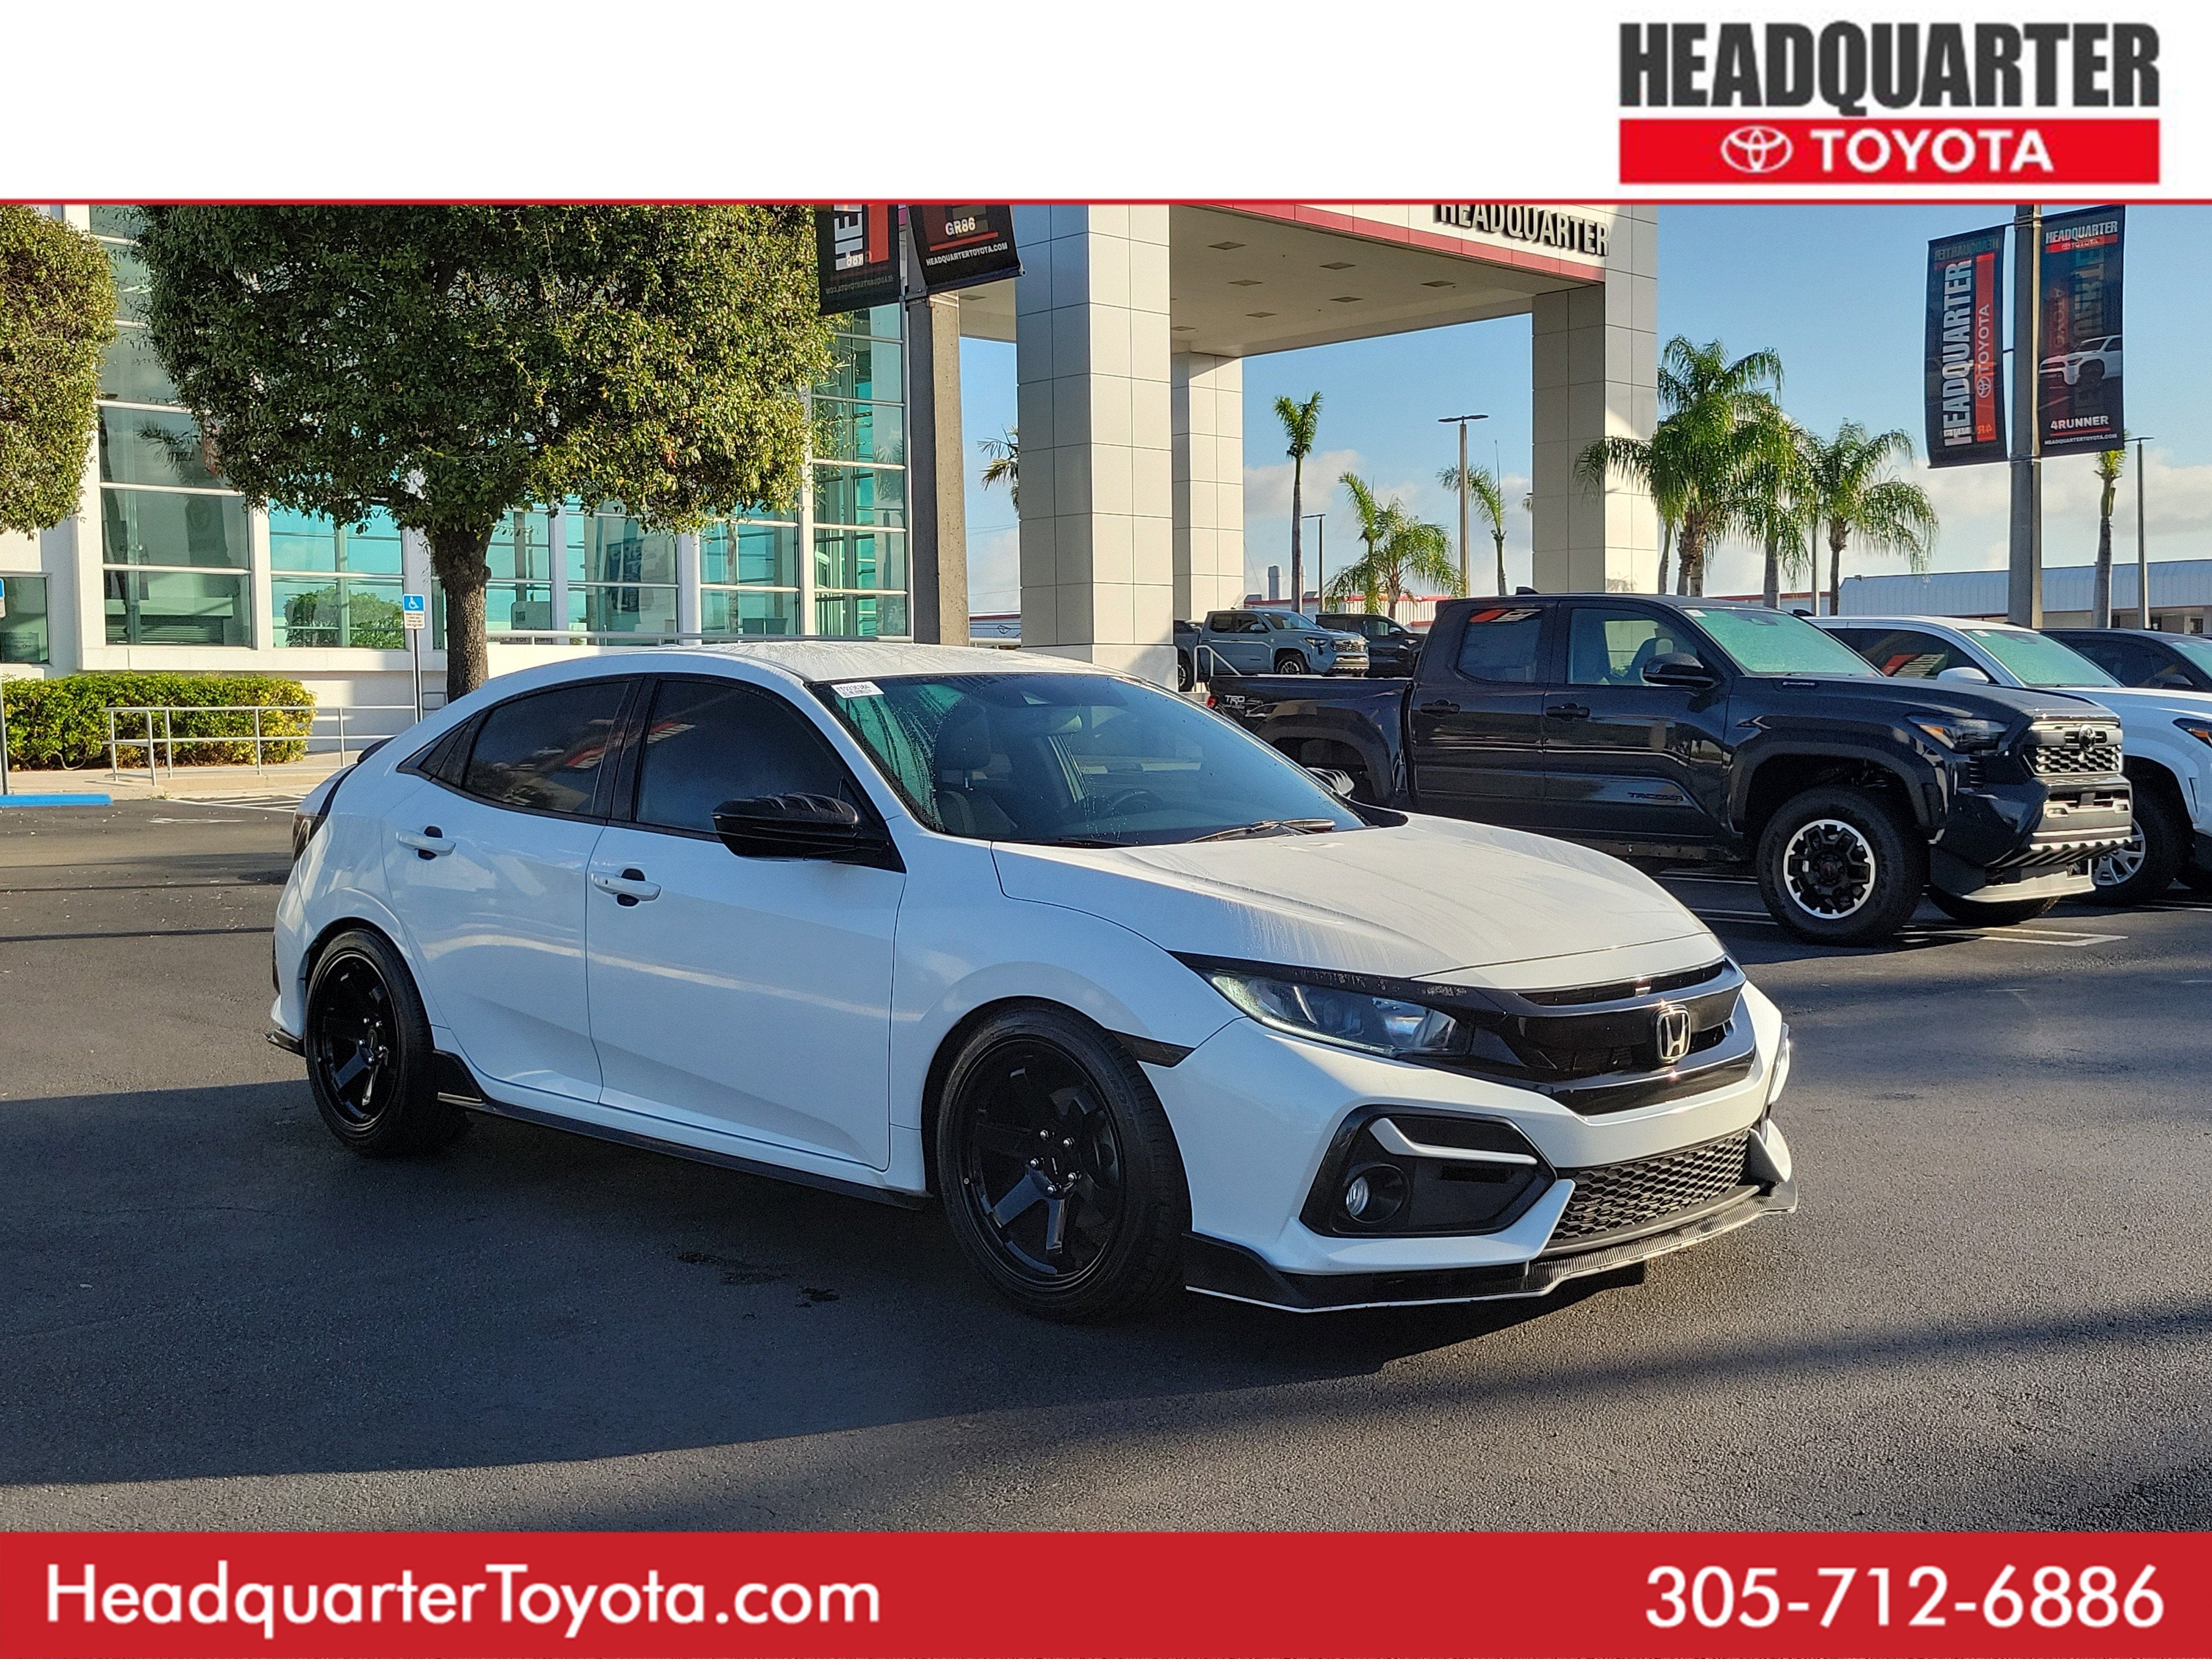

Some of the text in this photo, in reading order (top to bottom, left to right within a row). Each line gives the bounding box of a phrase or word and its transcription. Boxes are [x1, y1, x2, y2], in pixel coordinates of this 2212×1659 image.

[834, 205, 864, 270] HE
[945, 217, 976, 236] GR86
[1438, 205, 1609, 257] HEADQUARTER
[2045, 221, 2118, 244] HEADQUARTER
[926, 242, 1008, 266] HEADQUARTERTOYOTA.COM
[2071, 238, 2098, 248] TOYOTA
[1978, 303, 1990, 375] TOYOTA
[1942, 259, 1974, 446] HEADQUARTER
[2050, 415, 2109, 430] 4RUNNER
[1224, 695, 1245, 704] TRD
